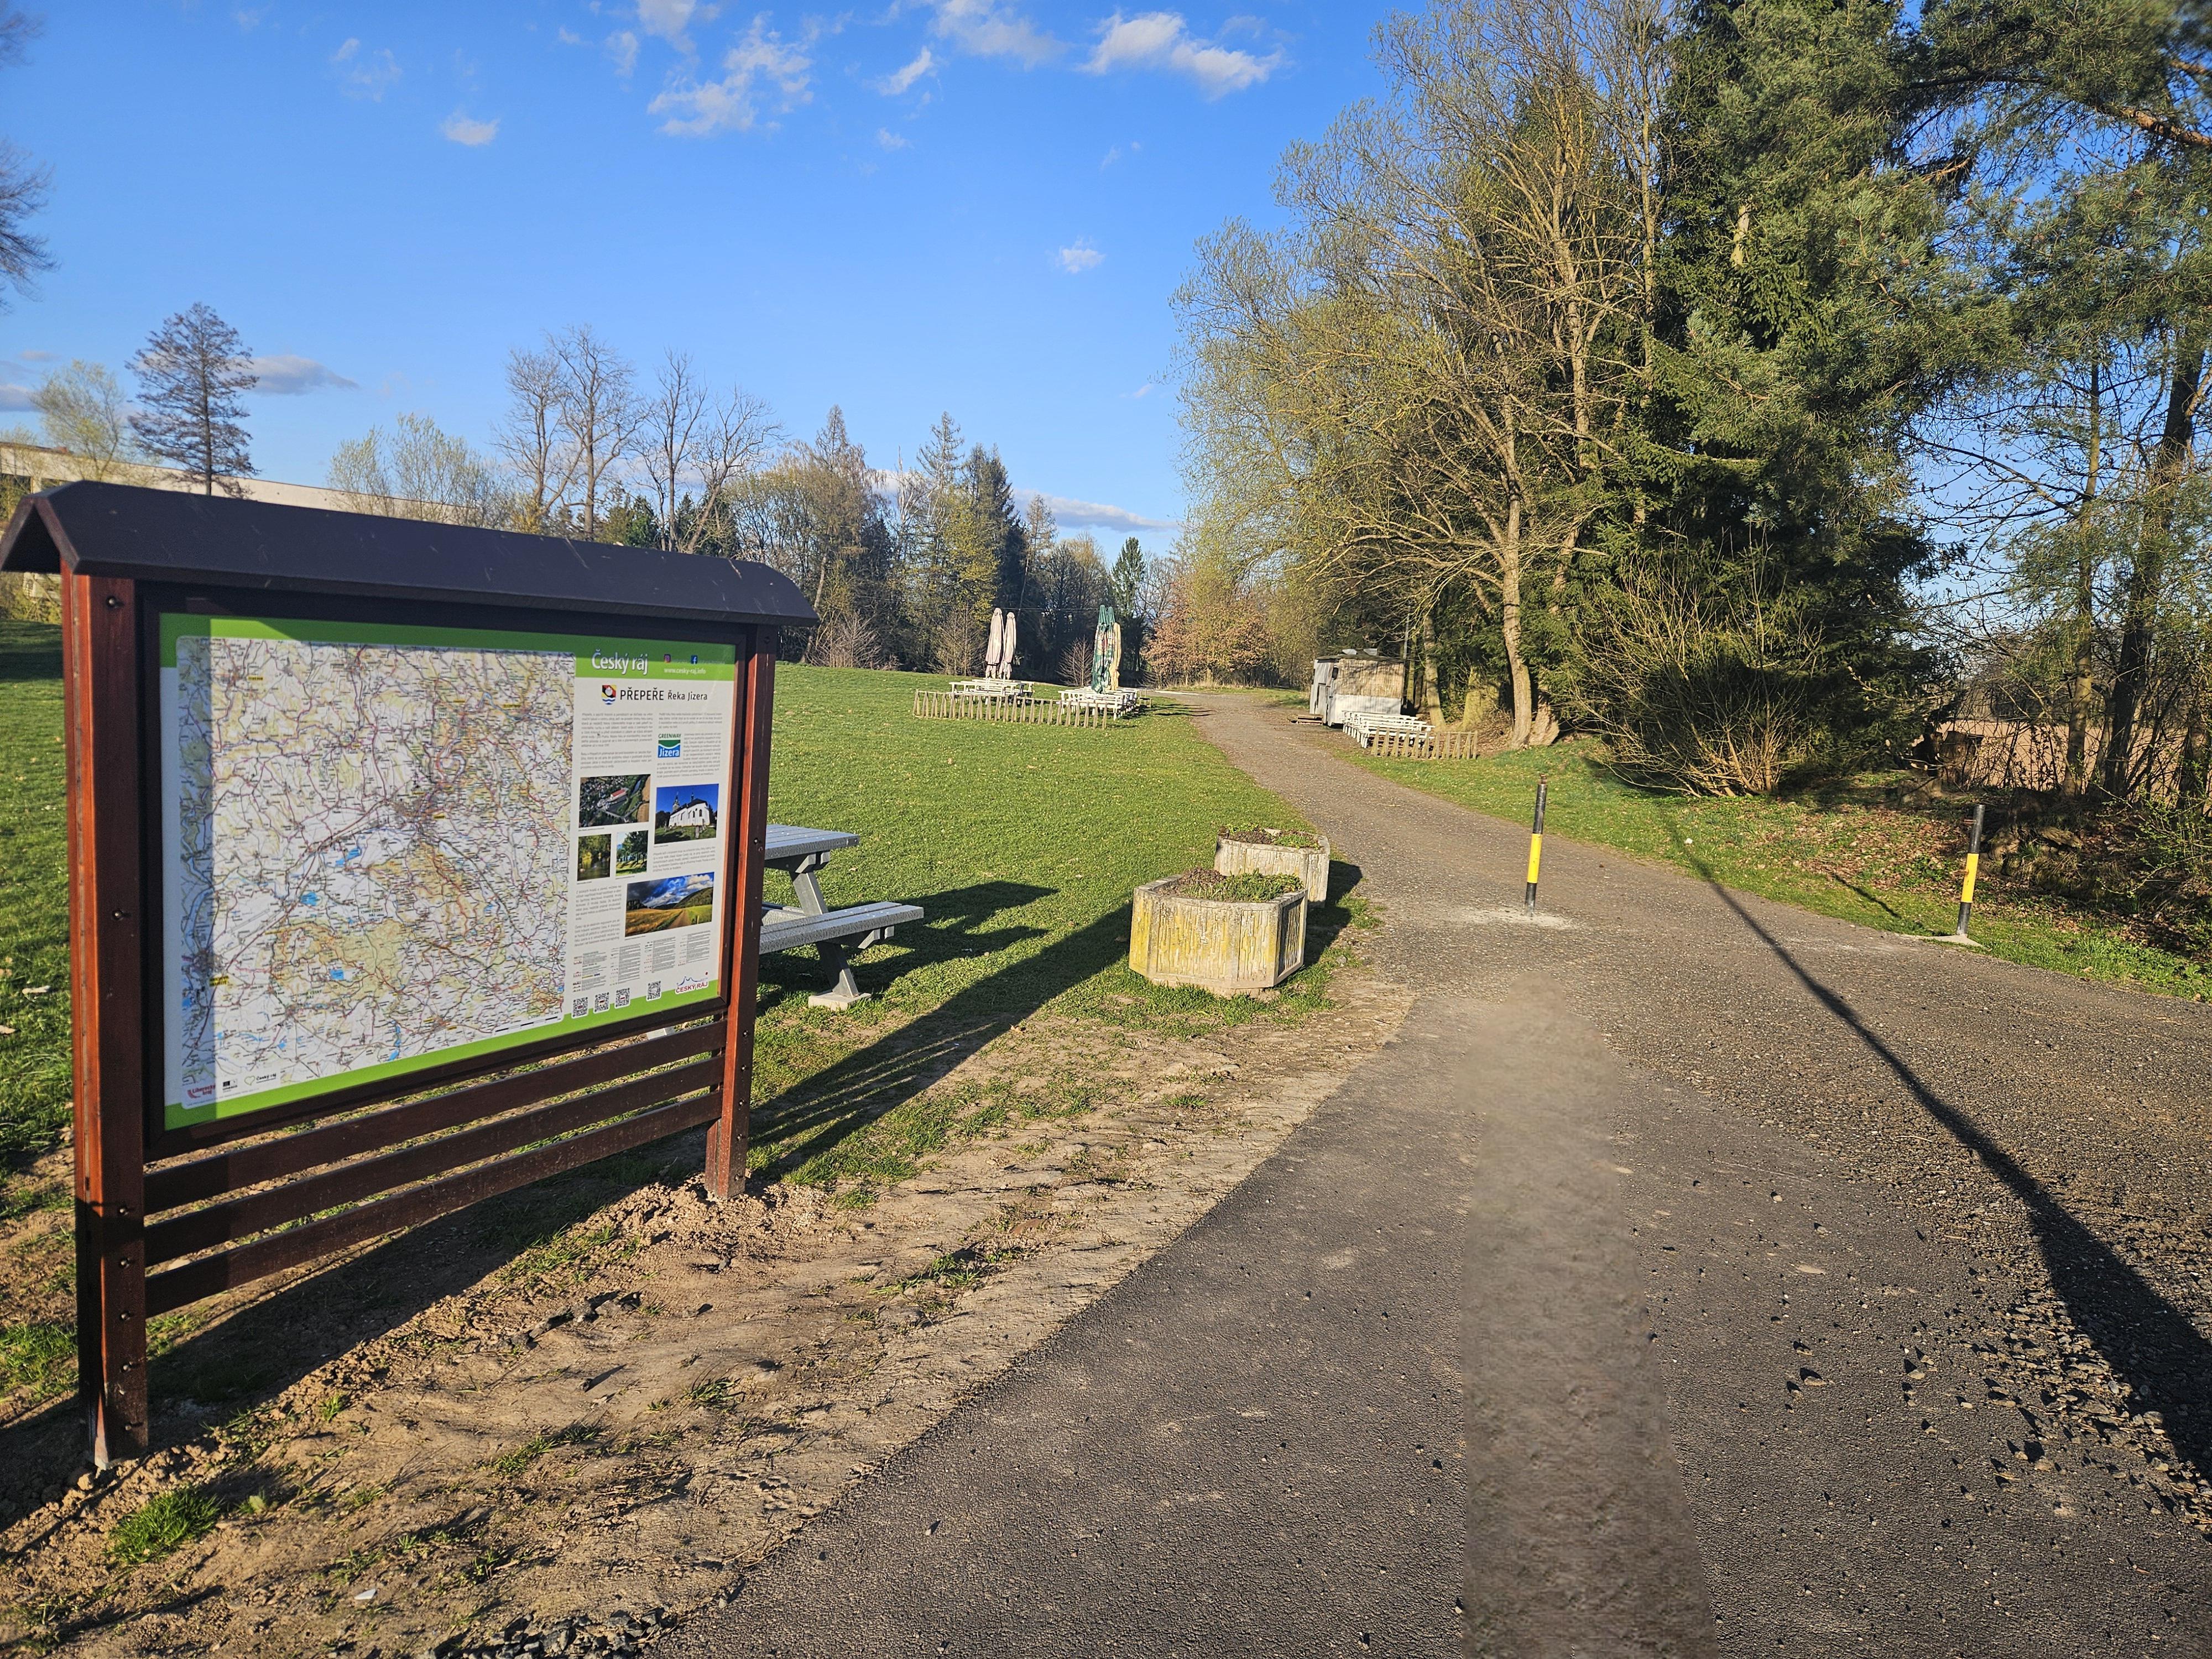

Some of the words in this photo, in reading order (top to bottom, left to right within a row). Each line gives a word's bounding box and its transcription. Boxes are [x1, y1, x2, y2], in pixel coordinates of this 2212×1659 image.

[591, 649, 629, 675] Český
[632, 653, 649, 675] ráj
[620, 687, 664, 701] PŘEPEŘE
[667, 690, 685, 700] Řeka
[687, 691, 708, 701] Jizera
[659, 748, 680, 757] Jizera
[676, 983, 696, 993] ČESKÝ
